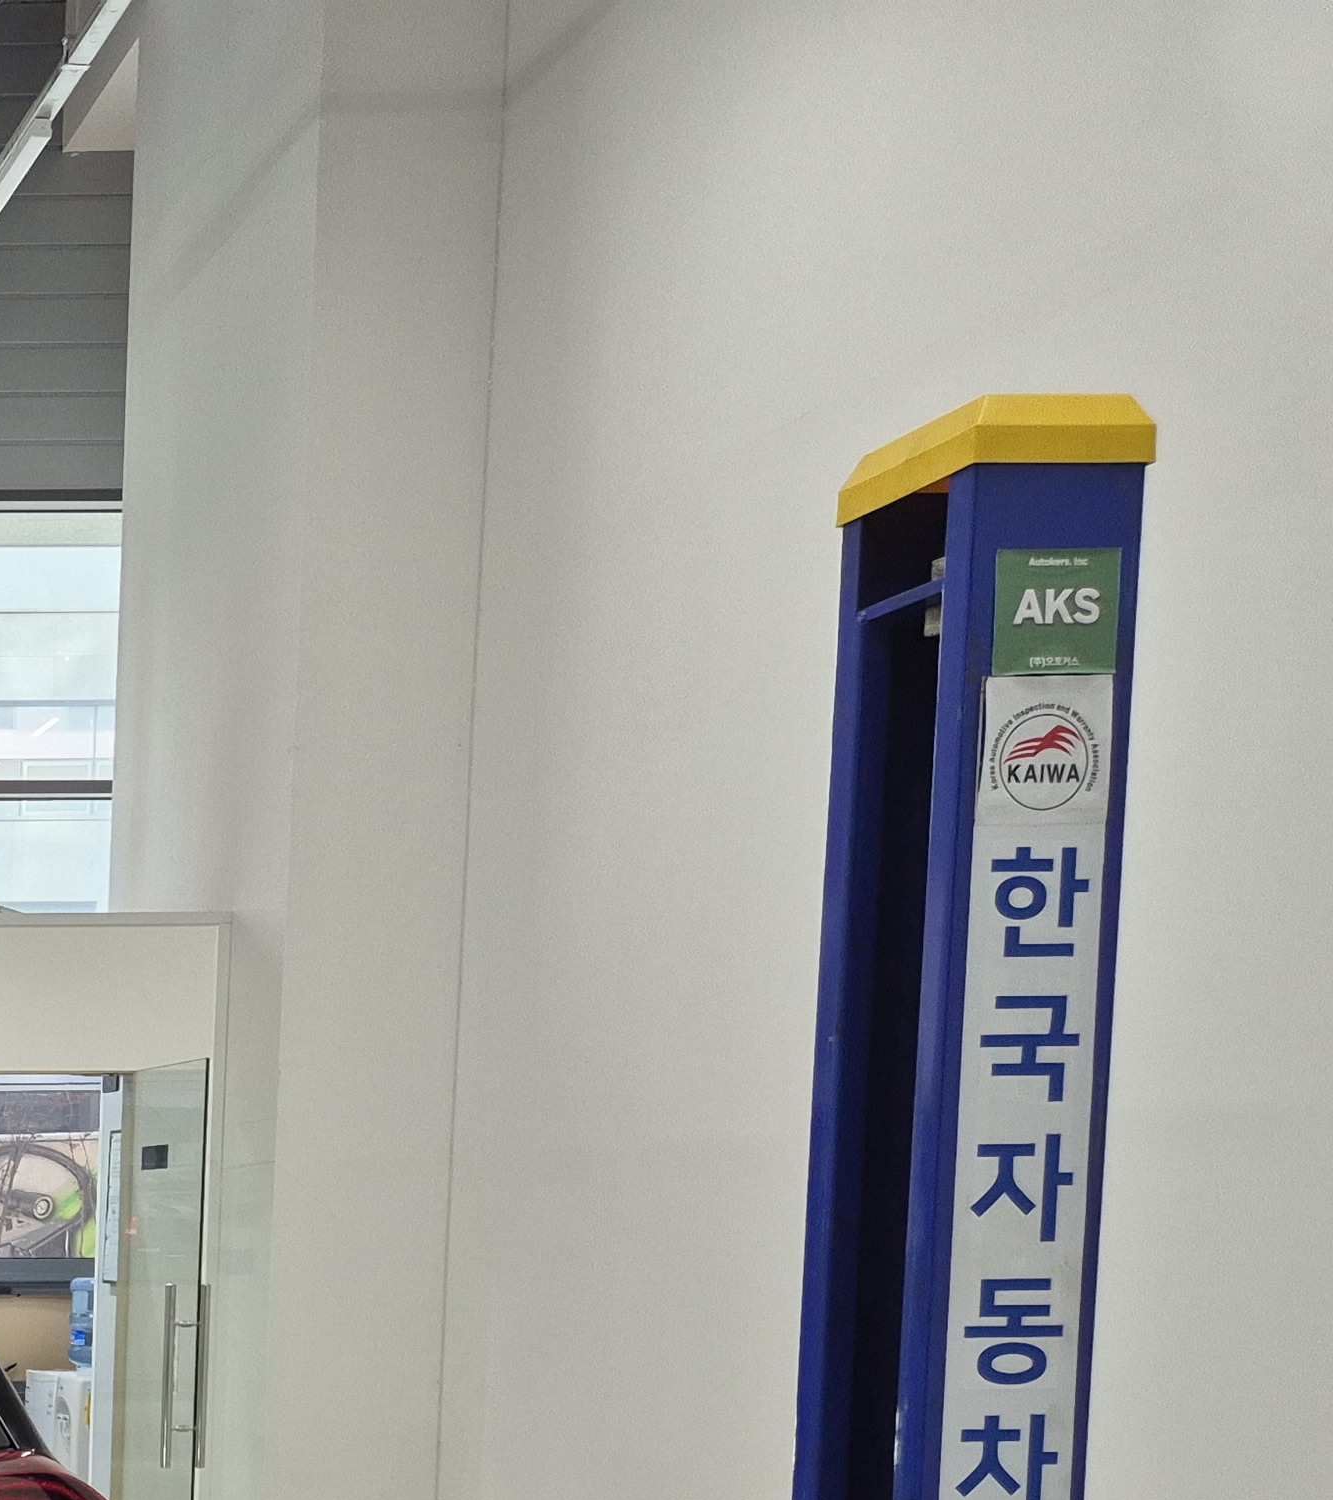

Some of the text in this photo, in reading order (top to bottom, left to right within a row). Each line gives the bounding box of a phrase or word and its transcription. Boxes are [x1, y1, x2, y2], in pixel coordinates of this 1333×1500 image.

[1012, 588, 1101, 625] AKS
[1013, 702, 1056, 721] Inspection
[1056, 704, 1071, 715] and
[1071, 710, 1095, 741] Warranty
[1007, 763, 1081, 784] KAIWA
